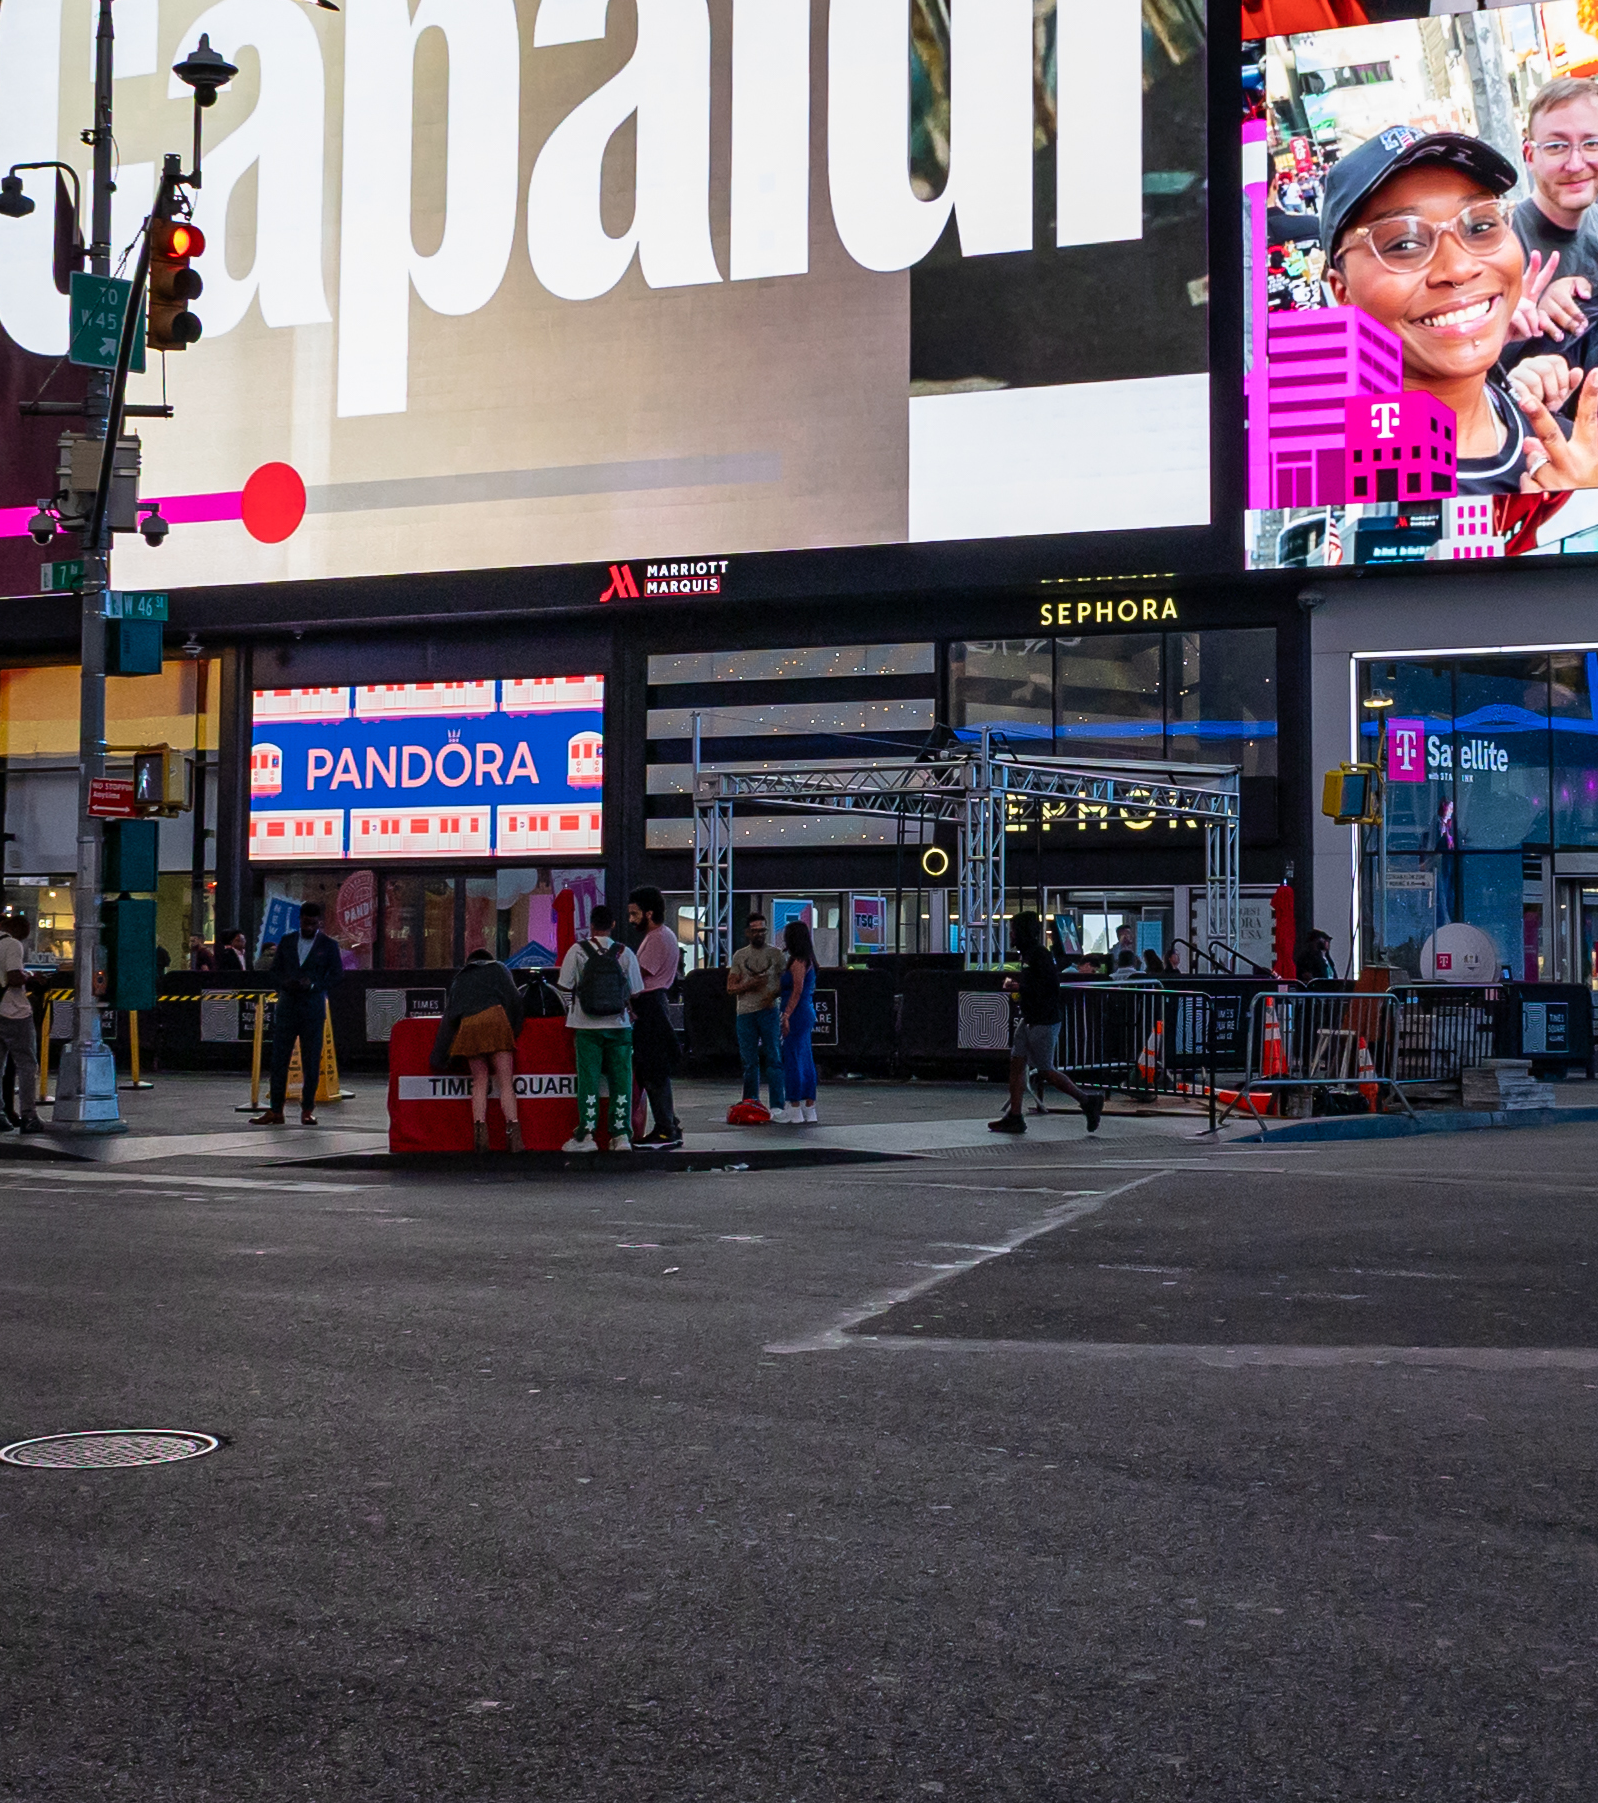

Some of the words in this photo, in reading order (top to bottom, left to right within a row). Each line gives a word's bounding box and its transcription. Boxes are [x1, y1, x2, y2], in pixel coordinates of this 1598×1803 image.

[99, 286, 118, 306] TO
[60, 565, 67, 585] 7
[646, 561, 729, 577] MARRIOTT
[646, 577, 720, 594] MARQUIS
[124, 595, 134, 615] W
[137, 596, 153, 617] 46
[1039, 597, 1178, 626] SEPHORA
[1427, 735, 1509, 773] Saellite
[305, 741, 540, 791] PANDORA
[412, 999, 439, 1010] TIMES
[513, 1076, 578, 1095] QUAR
